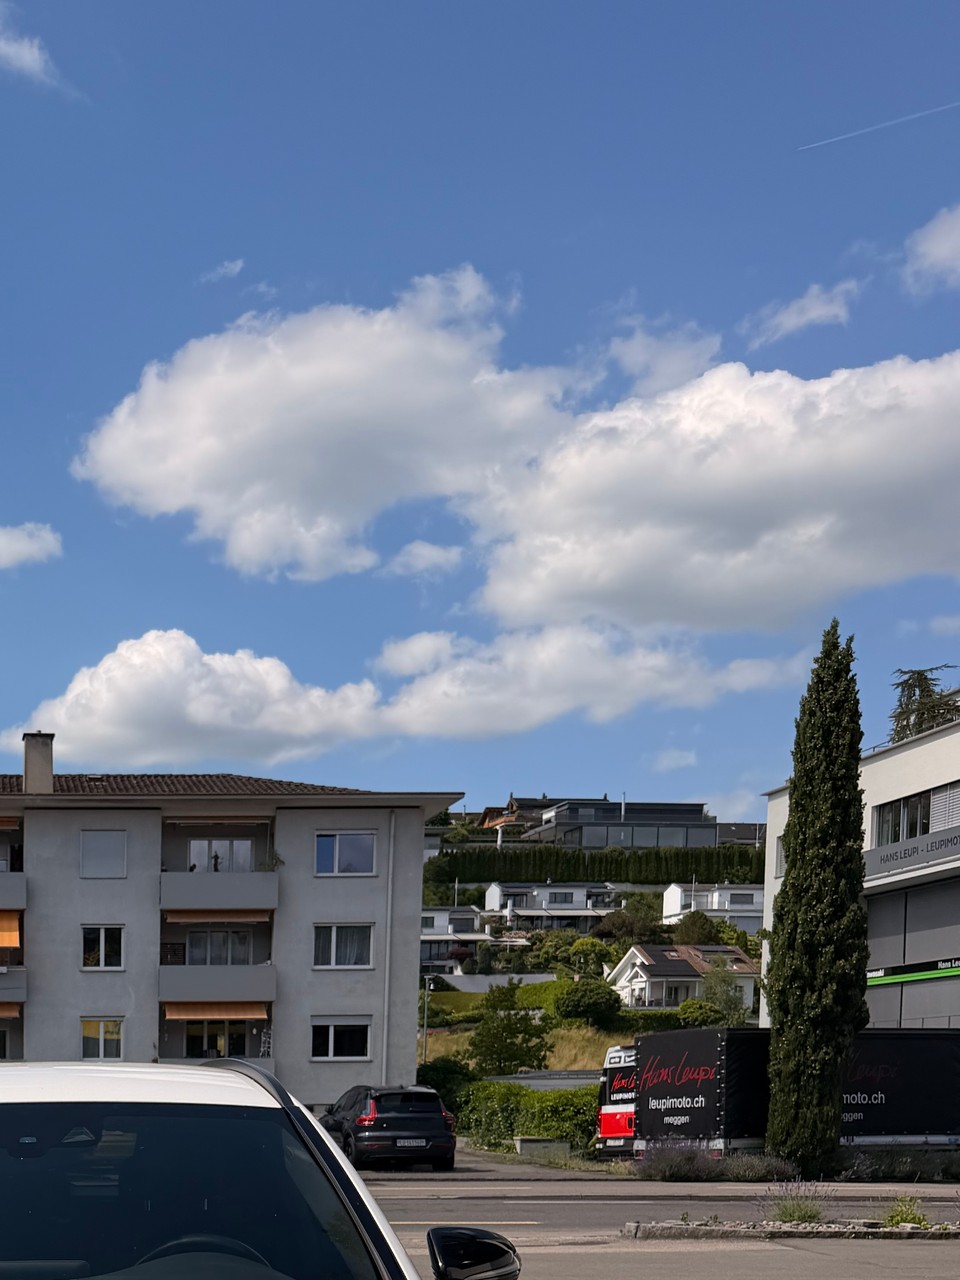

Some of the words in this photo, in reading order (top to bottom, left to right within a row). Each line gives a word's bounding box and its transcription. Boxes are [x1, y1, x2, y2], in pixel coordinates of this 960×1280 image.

[880, 852, 899, 864] HANS
[900, 846, 919, 860] LEUPI
[640, 1055, 675, 1092] Hans
[675, 1051, 719, 1089] Leupi
[648, 1095, 705, 1111] leupimoto.ch
